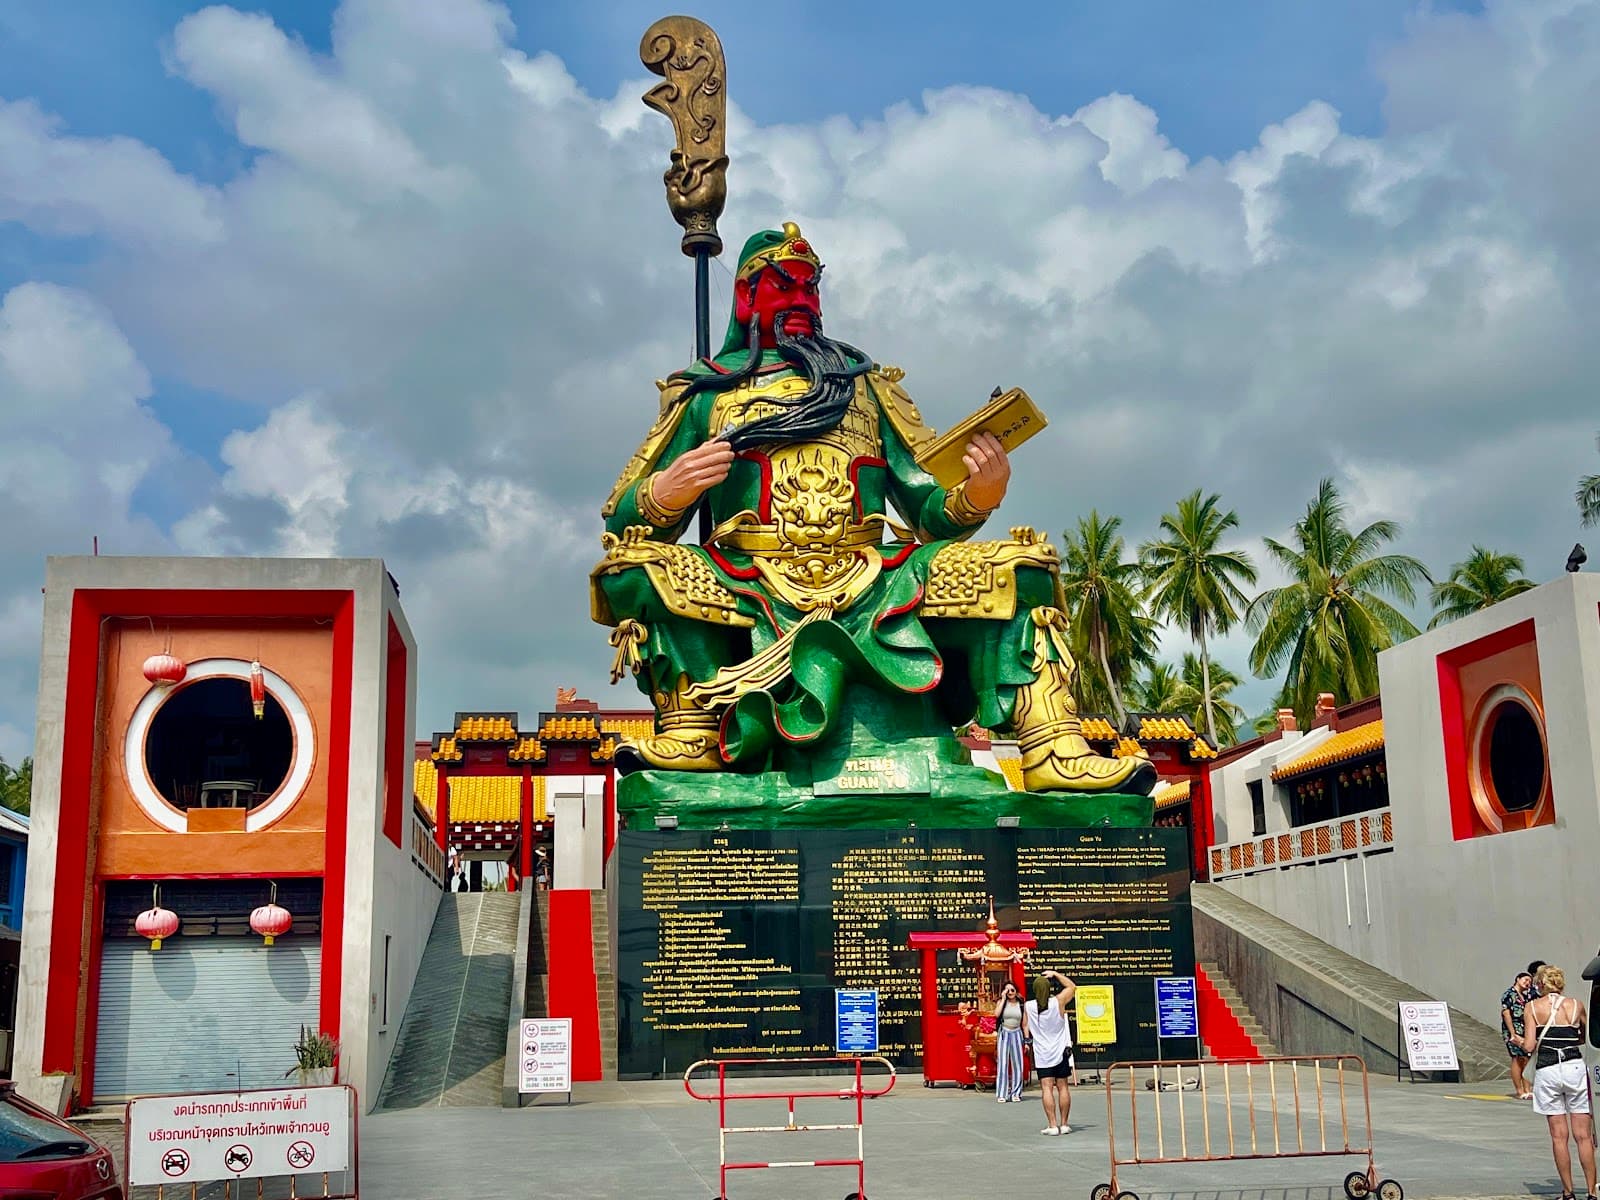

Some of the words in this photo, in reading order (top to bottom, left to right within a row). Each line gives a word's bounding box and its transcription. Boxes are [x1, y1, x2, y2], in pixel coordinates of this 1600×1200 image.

[838, 776, 880, 790] GUAN
[174, 1094, 307, 1118] งดนำรถทุกประเภทเข้าพื้นที่
[148, 1121, 330, 1143] บริเวณหน้าจุดกราบไหว้เทพเจ้ากวนอู
